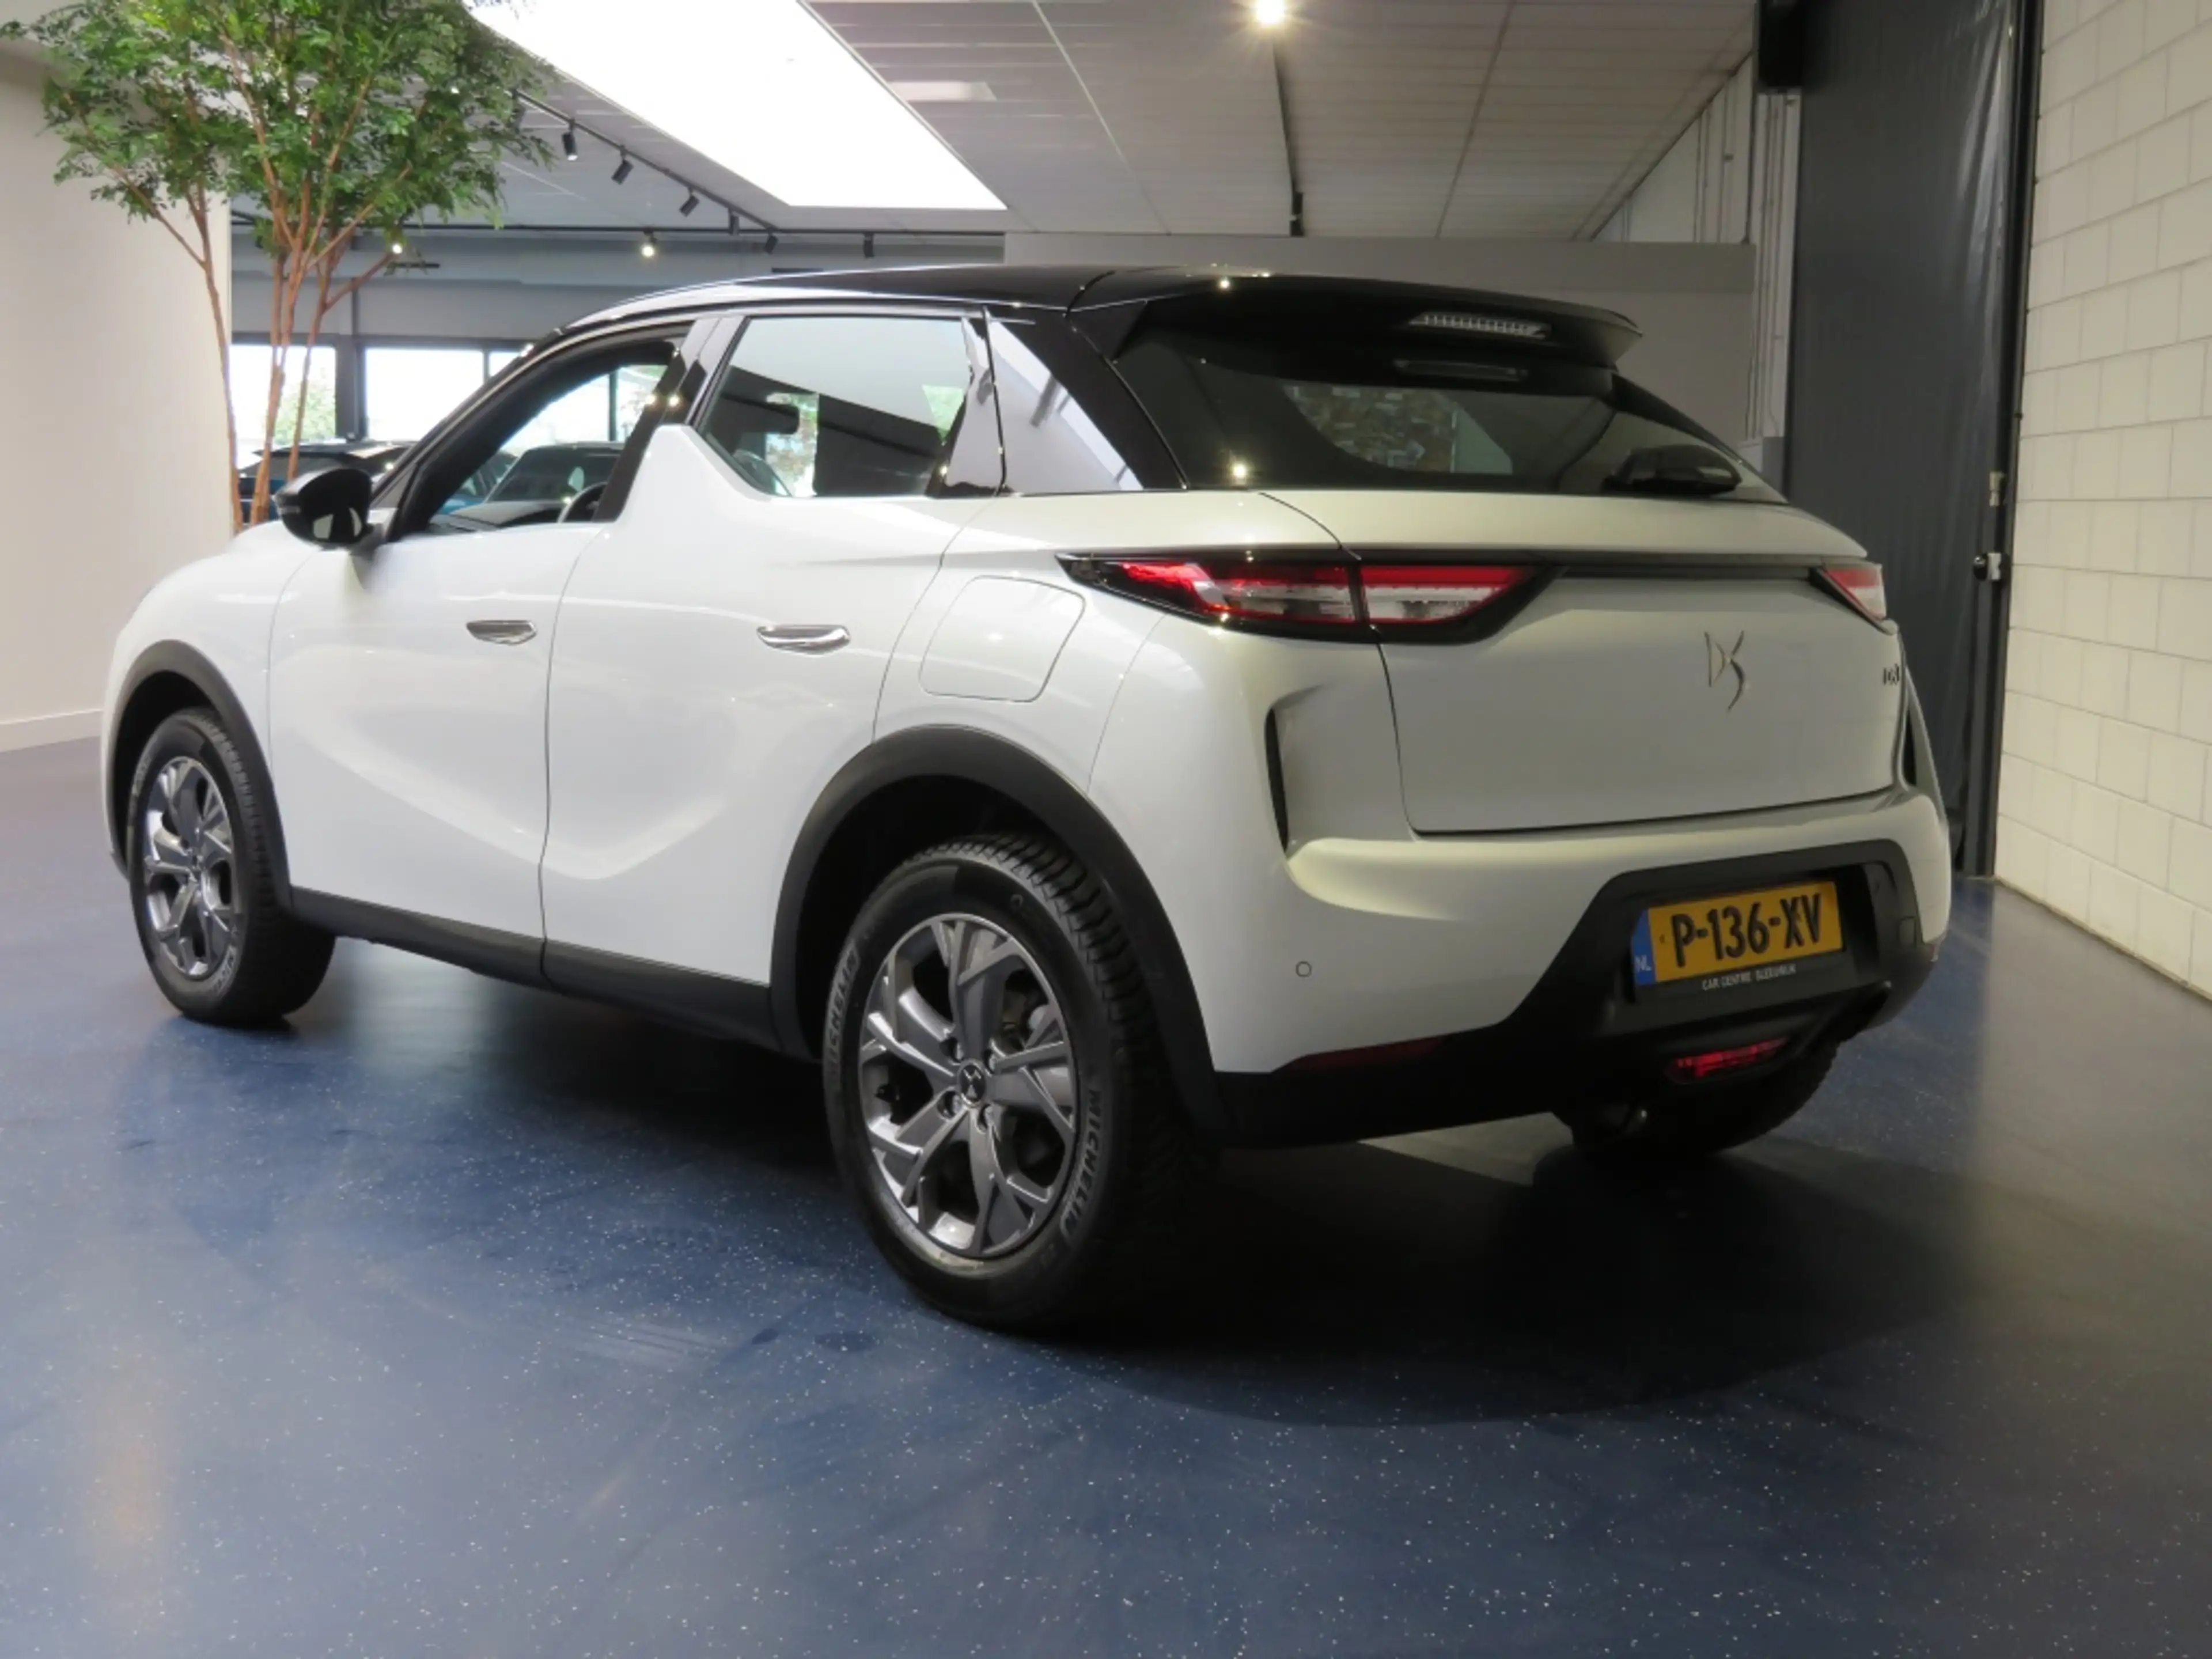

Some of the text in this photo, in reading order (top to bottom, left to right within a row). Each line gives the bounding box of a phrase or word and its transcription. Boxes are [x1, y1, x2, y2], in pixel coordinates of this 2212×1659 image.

[1671, 892, 1821, 968] P-136-XV
[1635, 954, 1652, 973] NL
[1702, 978, 1719, 991] CAR
[1062, 1088, 1103, 1236] MICHELIN
